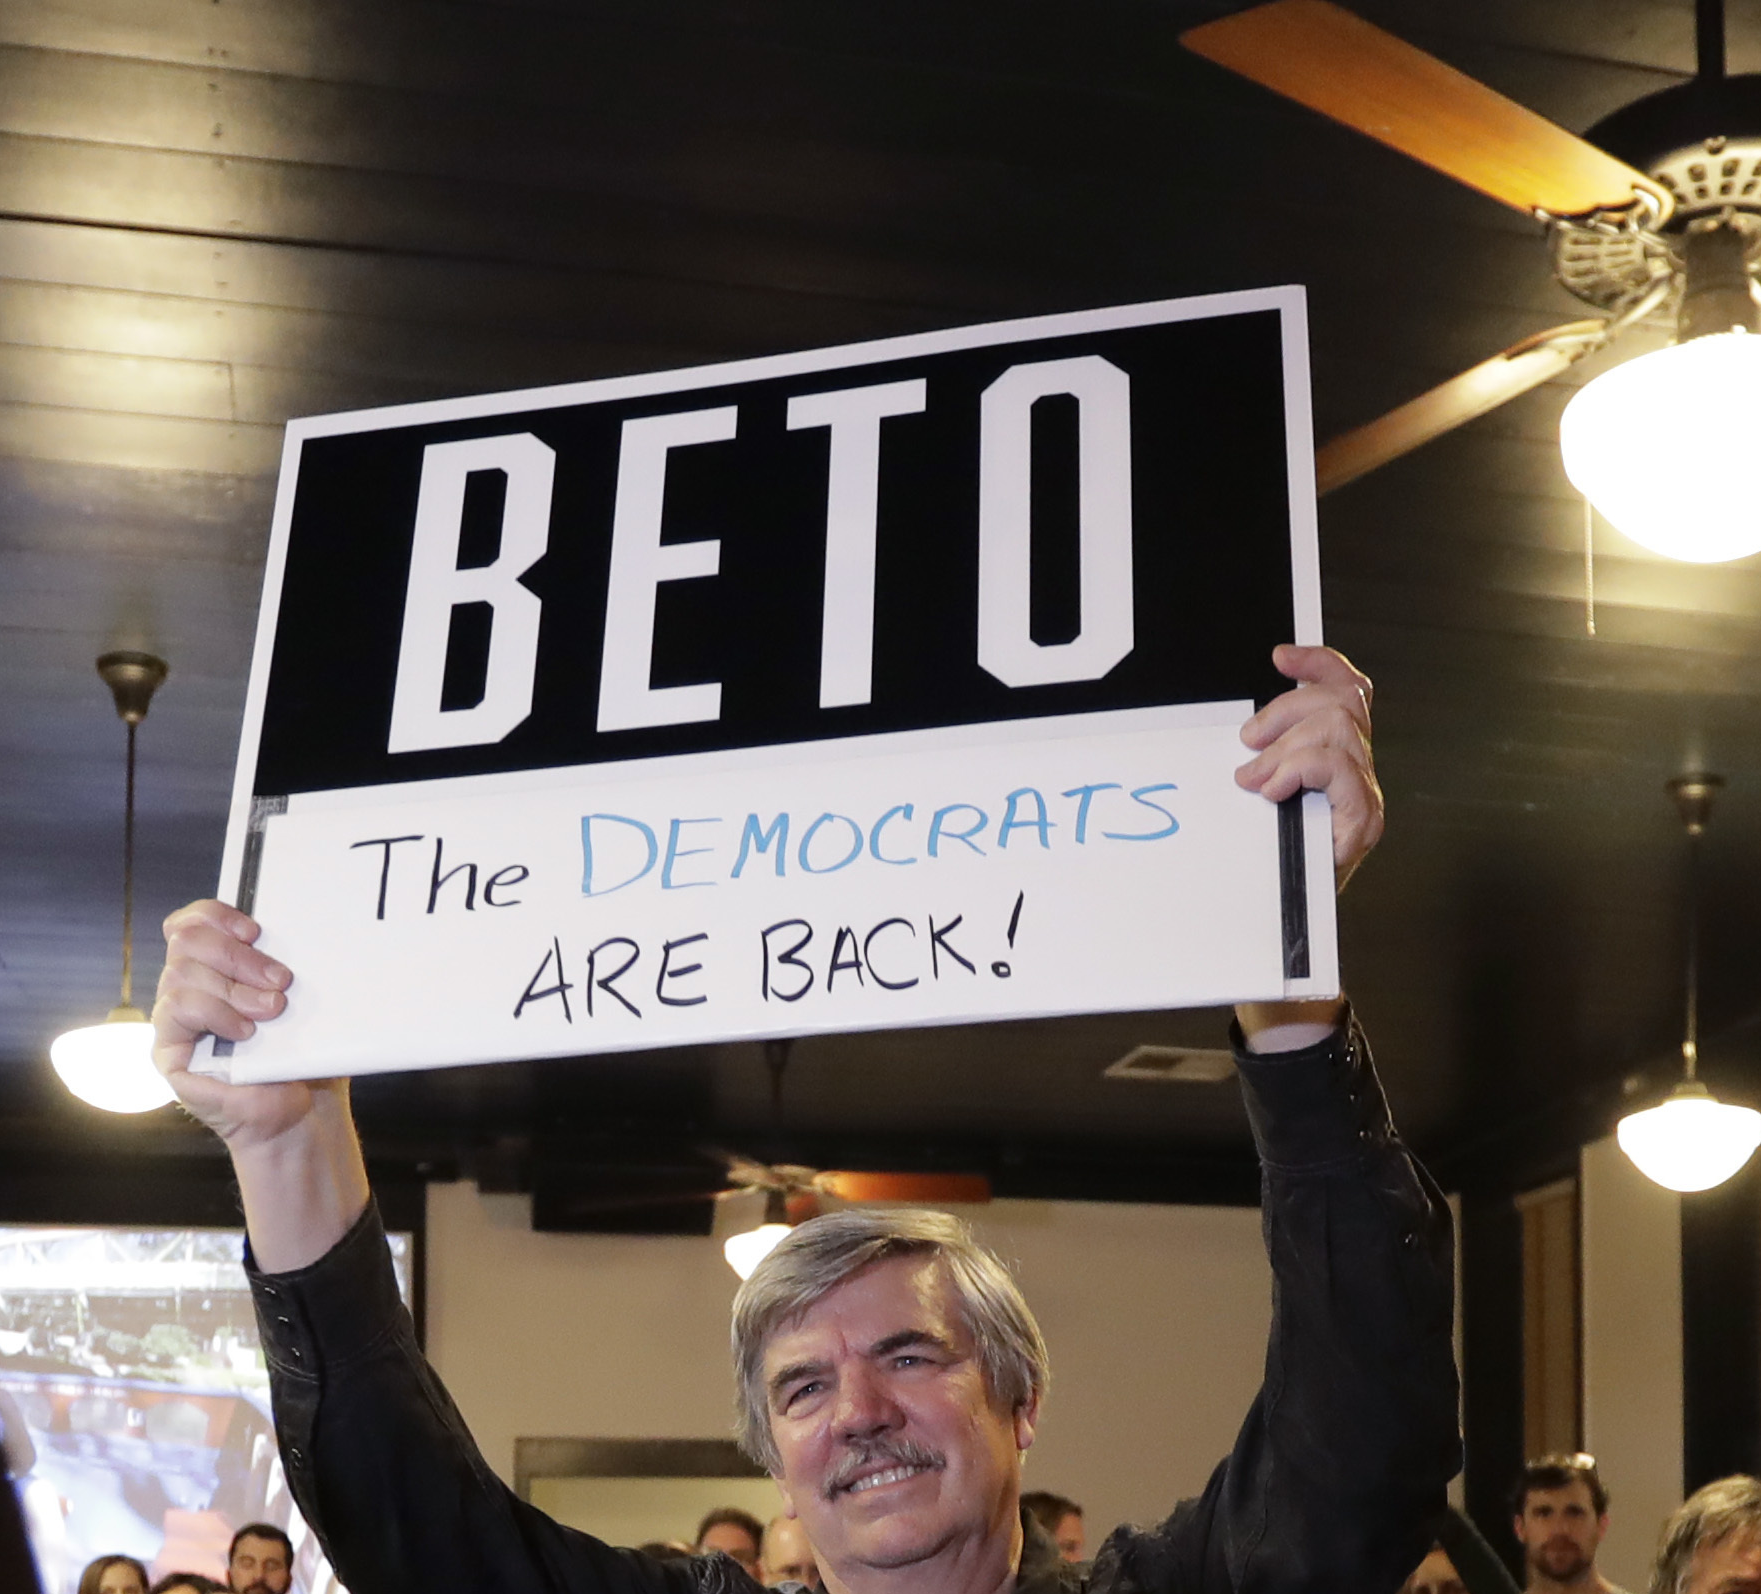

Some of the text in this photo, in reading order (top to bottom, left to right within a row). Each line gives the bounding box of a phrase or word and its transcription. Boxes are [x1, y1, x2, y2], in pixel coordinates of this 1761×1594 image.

[387, 354, 1135, 753] BETO
[349, 781, 1182, 921] The DEMOCRATS
[512, 891, 1026, 1024] ARE BACK!
